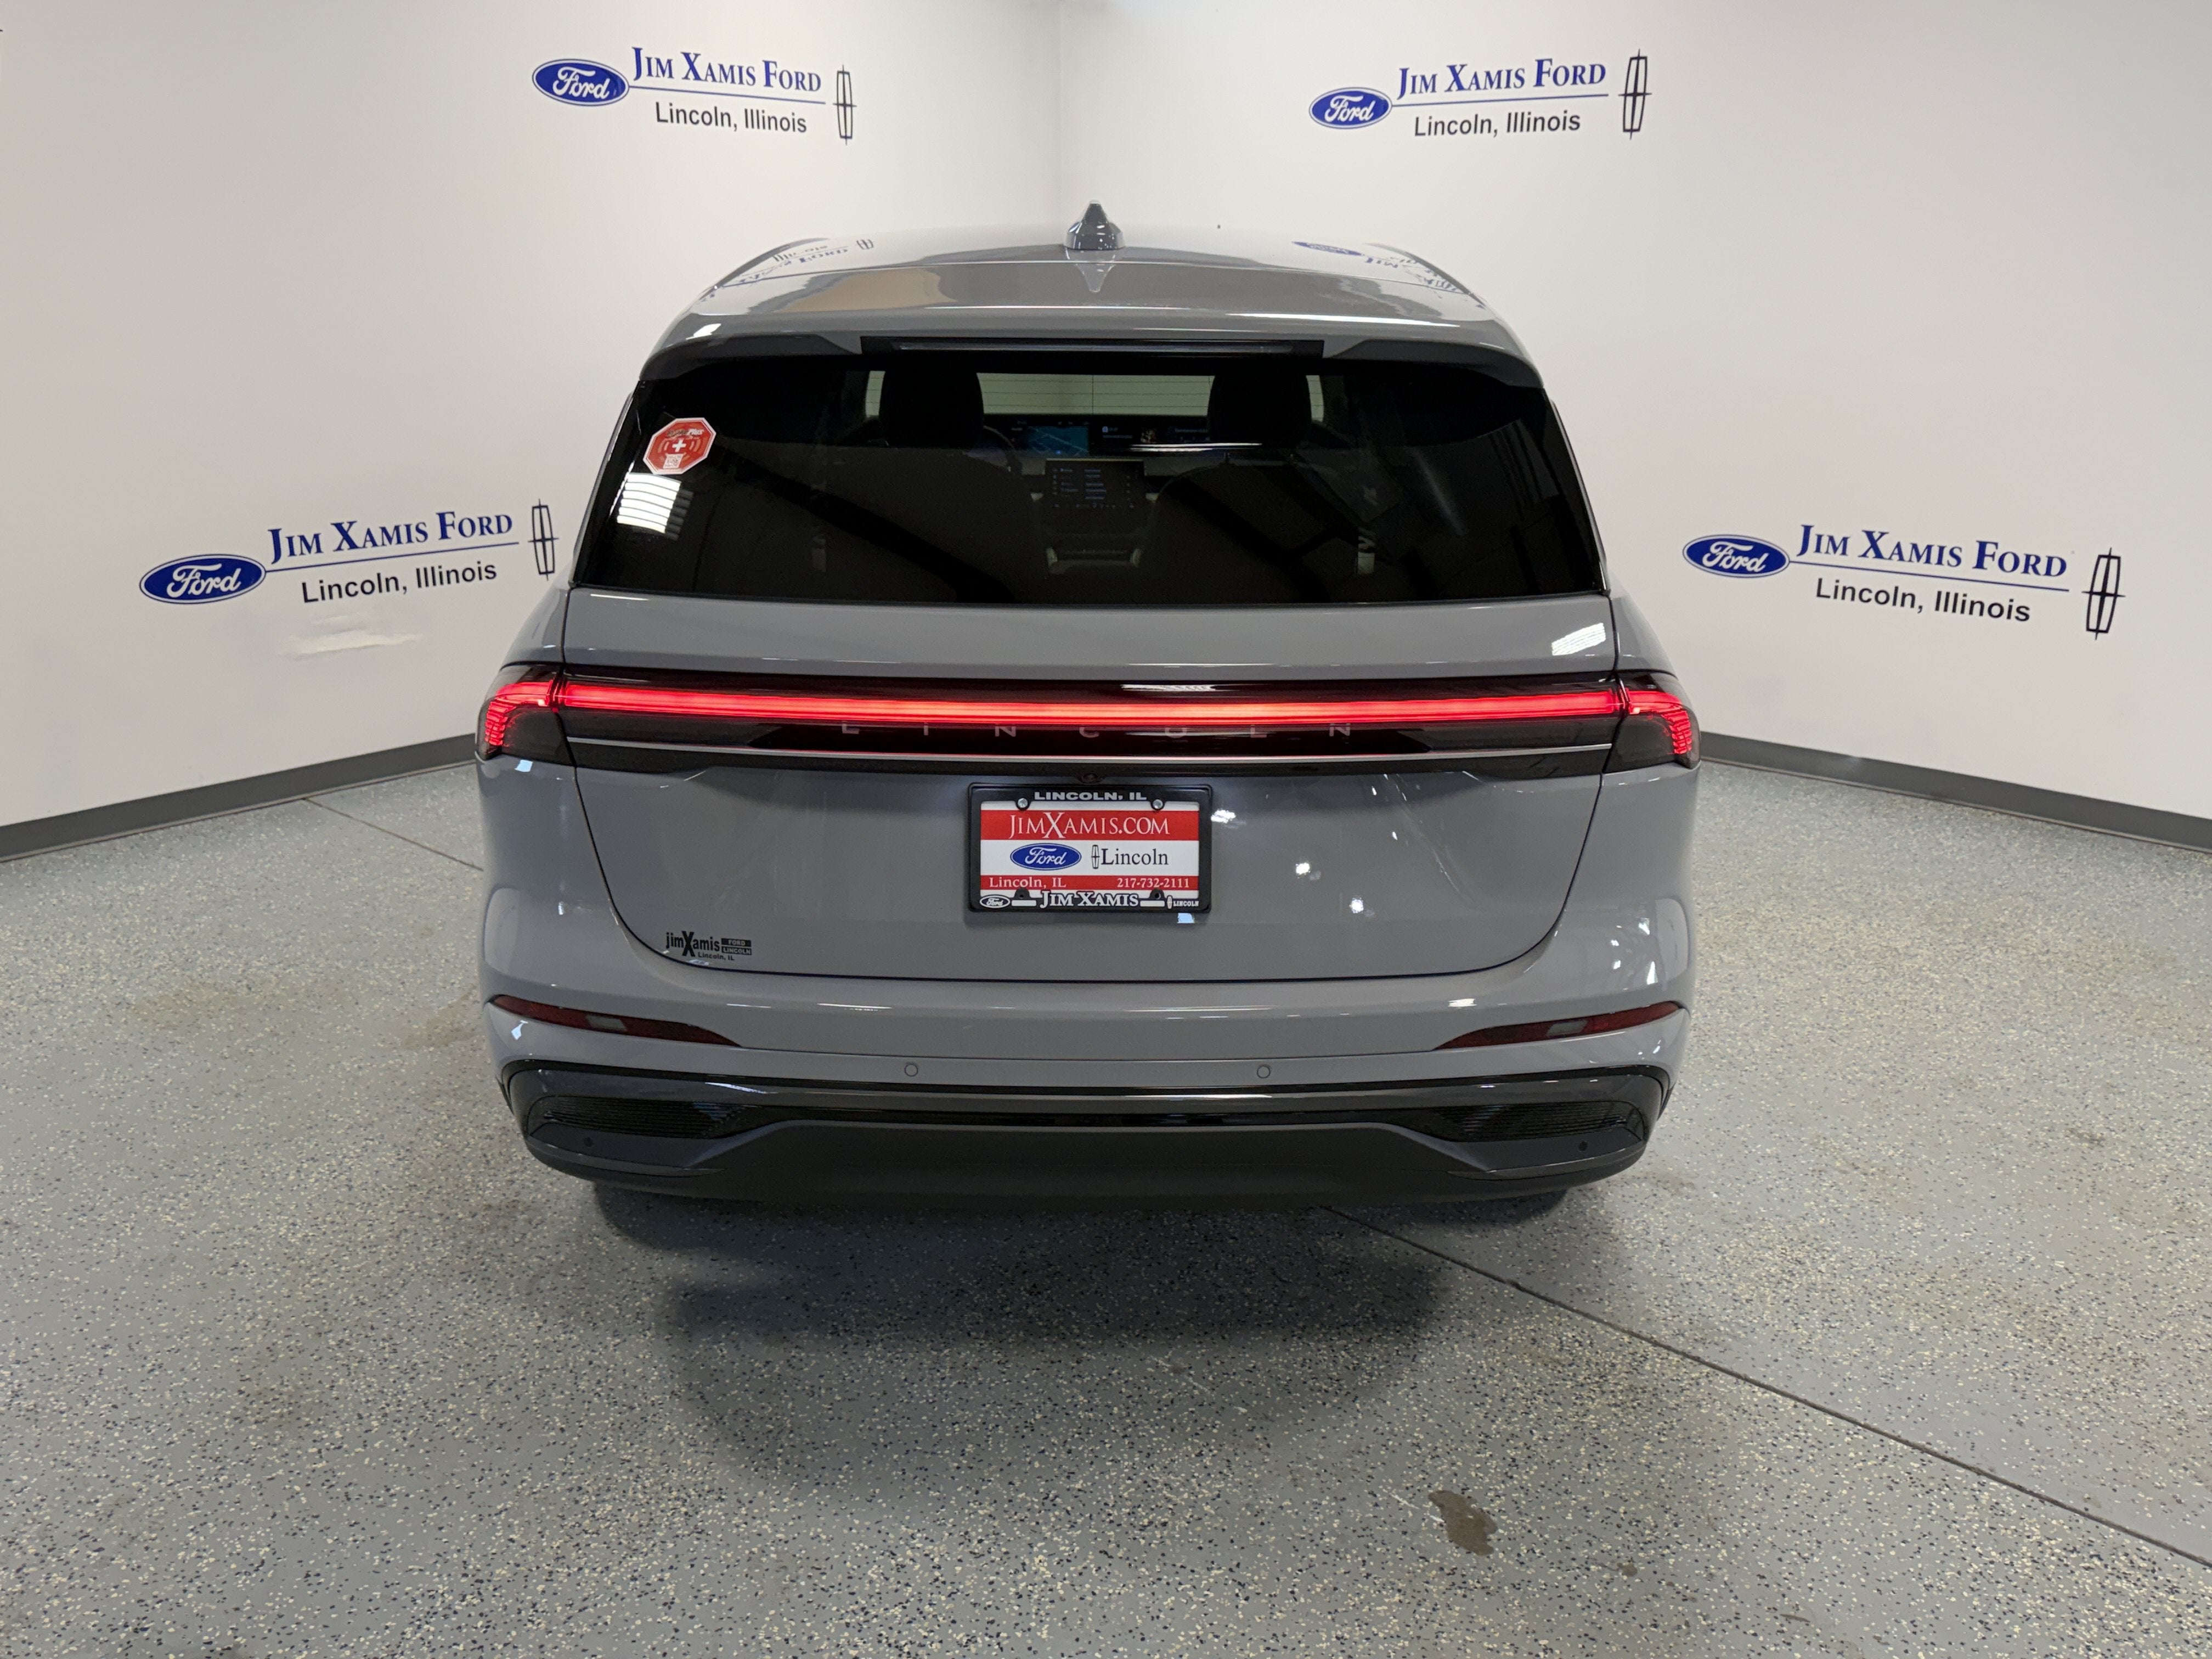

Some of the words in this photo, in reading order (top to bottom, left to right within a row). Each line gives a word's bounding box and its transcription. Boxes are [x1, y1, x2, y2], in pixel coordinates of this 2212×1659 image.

[552, 66, 610, 100] Ford
[631, 47, 675, 81] JIM
[681, 52, 756, 86] XAMIS
[763, 60, 822, 92] FORD
[1397, 67, 1437, 100] JIM
[1445, 64, 1525, 92] XAMIS
[1534, 58, 1606, 88] FORD
[656, 101, 738, 132] Lincoln,
[744, 109, 807, 133] Illinois
[1324, 95, 1374, 122] Ford
[1415, 114, 1498, 138] Lincoln,
[1507, 110, 1581, 133] Illinois
[268, 528, 324, 565] JIM
[331, 521, 428, 552] XAMIS
[436, 511, 513, 540] FORD
[1797, 524, 1849, 557] JIM
[1861, 529, 1962, 568] XAMIS
[1972, 540, 2067, 578] FORD
[1702, 543, 1767, 573] Ford
[167, 563, 241, 597] Ford
[302, 573, 408, 603] Lincoln,
[416, 561, 498, 589] Illinois
[1816, 578, 1924, 614] Lincoln,
[1935, 591, 2031, 622] Illinois
[842, 720, 1351, 738] LINCOLN
[1034, 791, 1124, 801] LINCOLN,
[1129, 792, 1147, 801] IL
[1025, 847, 1067, 866] Ford
[1101, 848, 1169, 866] Lincoln
[989, 877, 1047, 889] Lincoln,
[1052, 878, 1066, 888] IL
[1116, 878, 1190, 888] 217-732-2111
[1040, 890, 1075, 909] JIM
[1076, 891, 1139, 907] XAMIS
[698, 952, 726, 961] Lincoln,
